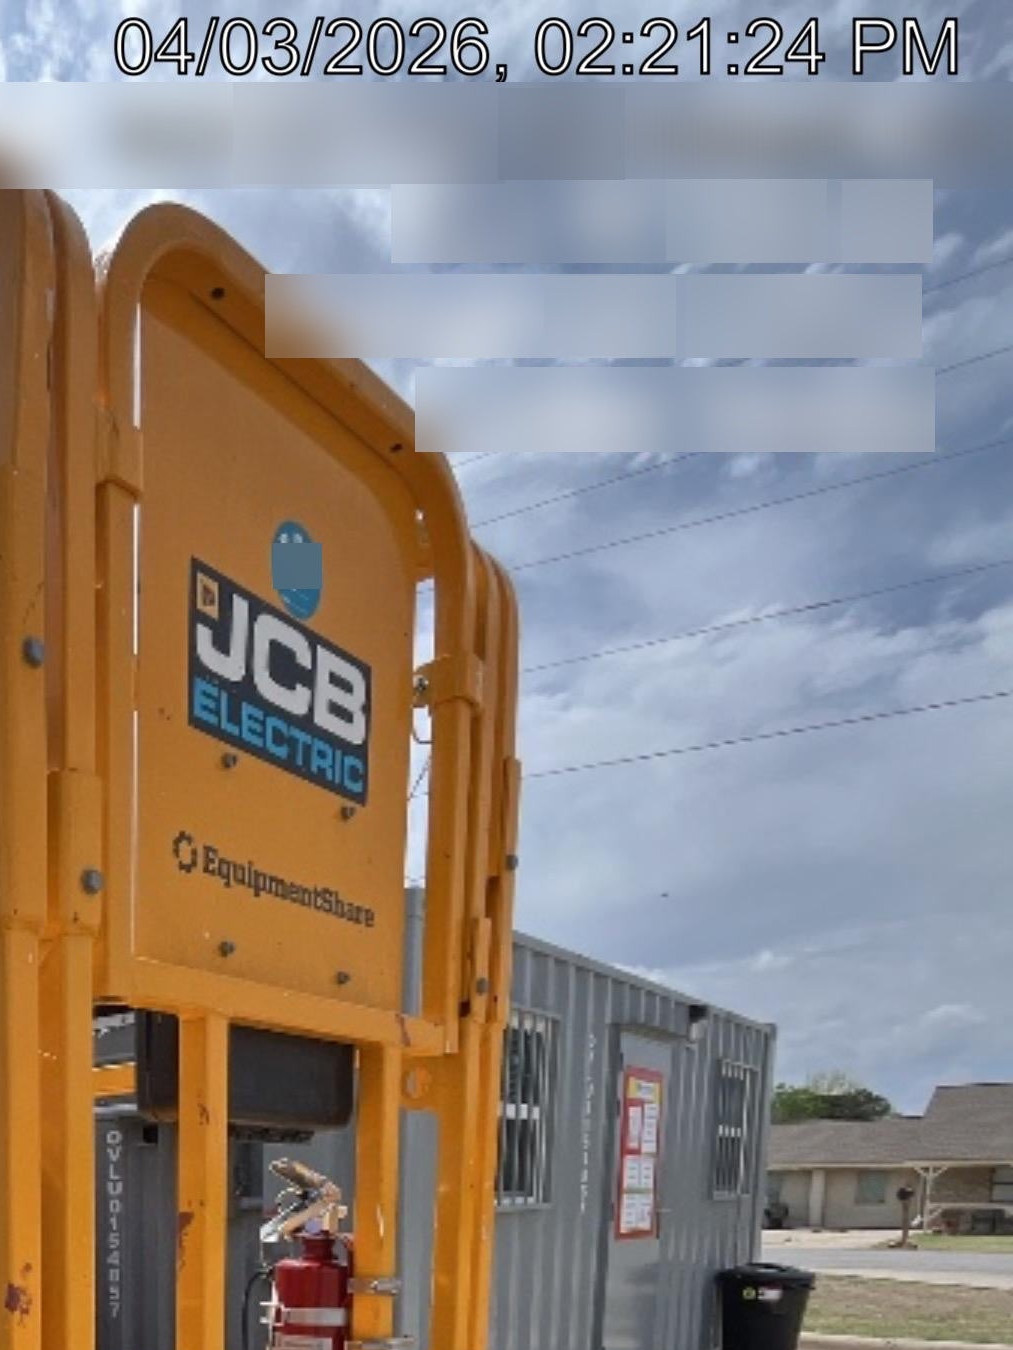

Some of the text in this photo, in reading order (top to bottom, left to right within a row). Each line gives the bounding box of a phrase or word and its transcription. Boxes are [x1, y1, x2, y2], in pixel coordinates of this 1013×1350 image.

[195, 592, 368, 746] JCB
[192, 681, 366, 795] ELECTRIC
[201, 843, 377, 930] EquipmentShare
